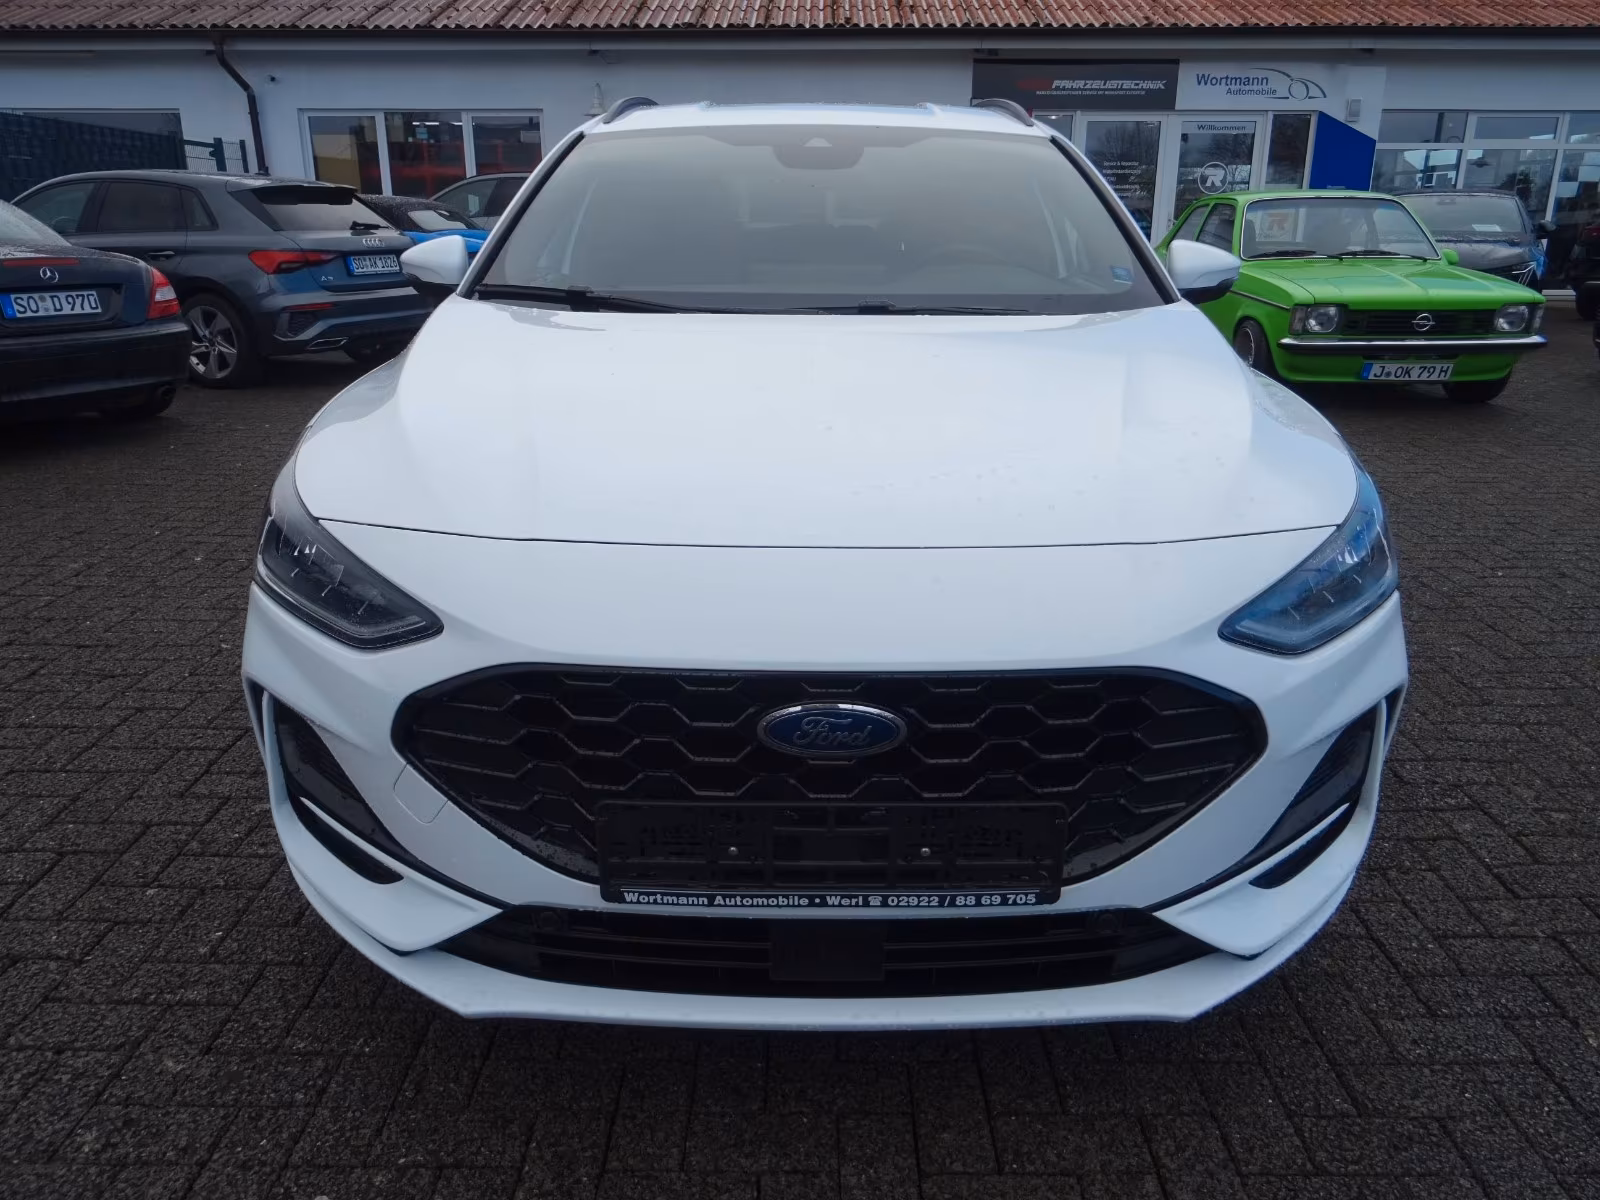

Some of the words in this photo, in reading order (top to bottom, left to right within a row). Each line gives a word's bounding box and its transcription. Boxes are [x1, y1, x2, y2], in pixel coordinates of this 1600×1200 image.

[1051, 80, 1167, 90] FAHRZEUGTECHNIK
[1196, 73, 1269, 87] Wortmann
[1225, 87, 1277, 96] Automobile
[353, 257, 364, 270] SO
[368, 256, 379, 269] AK
[380, 256, 398, 269] 1826
[14, 296, 40, 314] SO
[49, 295, 63, 312] D
[65, 293, 99, 311] 970
[1373, 366, 1386, 378] J
[1394, 366, 1415, 379] OK
[1417, 366, 1437, 379] 79
[1438, 366, 1450, 378] H
[793, 716, 873, 746] Ford
[624, 892, 709, 905] Wortmann
[713, 895, 809, 906] Automobile
[826, 896, 863, 906] Werl
[887, 896, 939, 906] 02922
[955, 896, 976, 906] 88
[980, 895, 1001, 905] 69
[1006, 894, 1036, 904] 705
